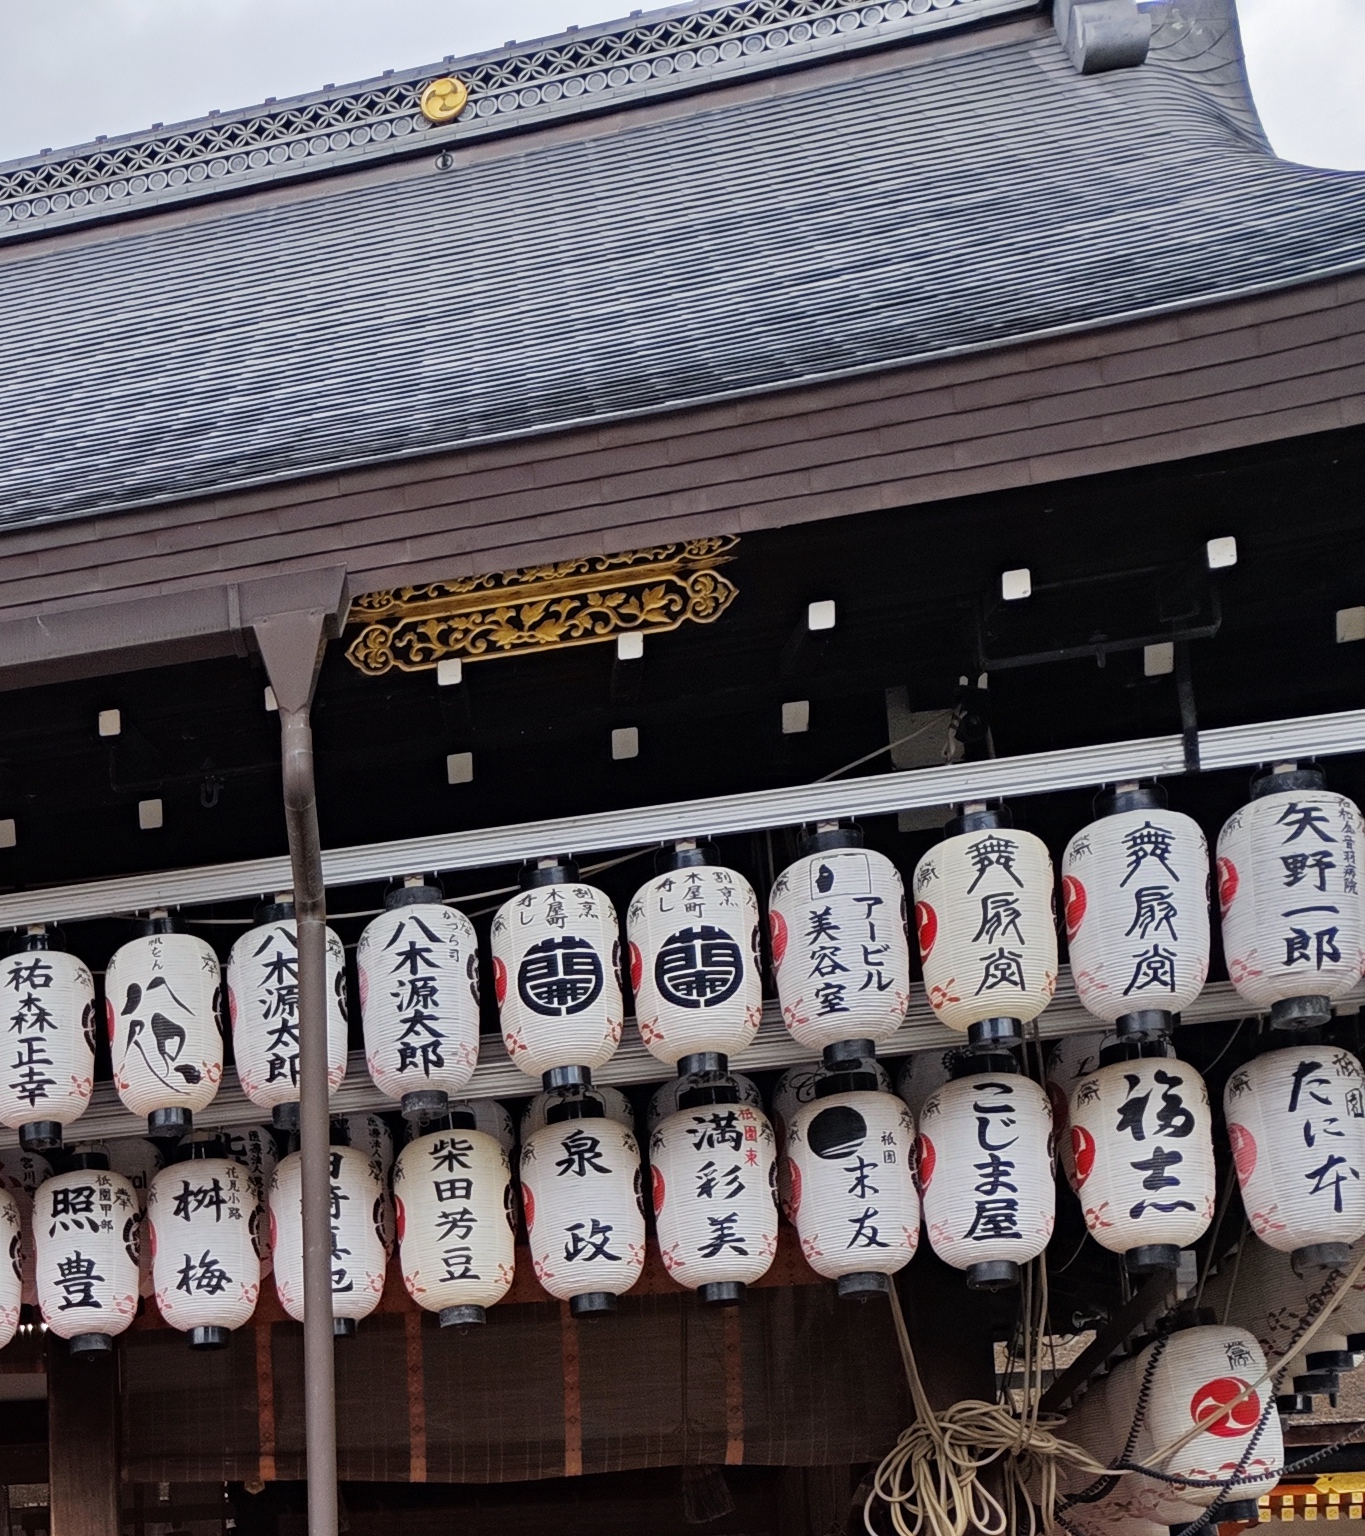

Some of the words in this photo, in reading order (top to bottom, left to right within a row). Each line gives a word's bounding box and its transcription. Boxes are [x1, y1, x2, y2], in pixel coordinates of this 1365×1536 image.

[544, 888, 567, 929] 木屋町
[683, 871, 705, 918] 木屋町
[1274, 802, 1341, 971] 矢野一郎
[382, 915, 449, 1078] 八木源太郎
[804, 905, 851, 1017] 美容室
[5, 958, 59, 1107] 祐森正幸
[226, 1166, 243, 1220] 花見小路
[428, 1137, 481, 1283] 柴田芳豆
[555, 1129, 622, 1262] 泉政
[685, 1110, 749, 1259] 満彩美
[962, 1082, 1023, 1241] こじま屋
[49, 1185, 106, 1311] 照豊
